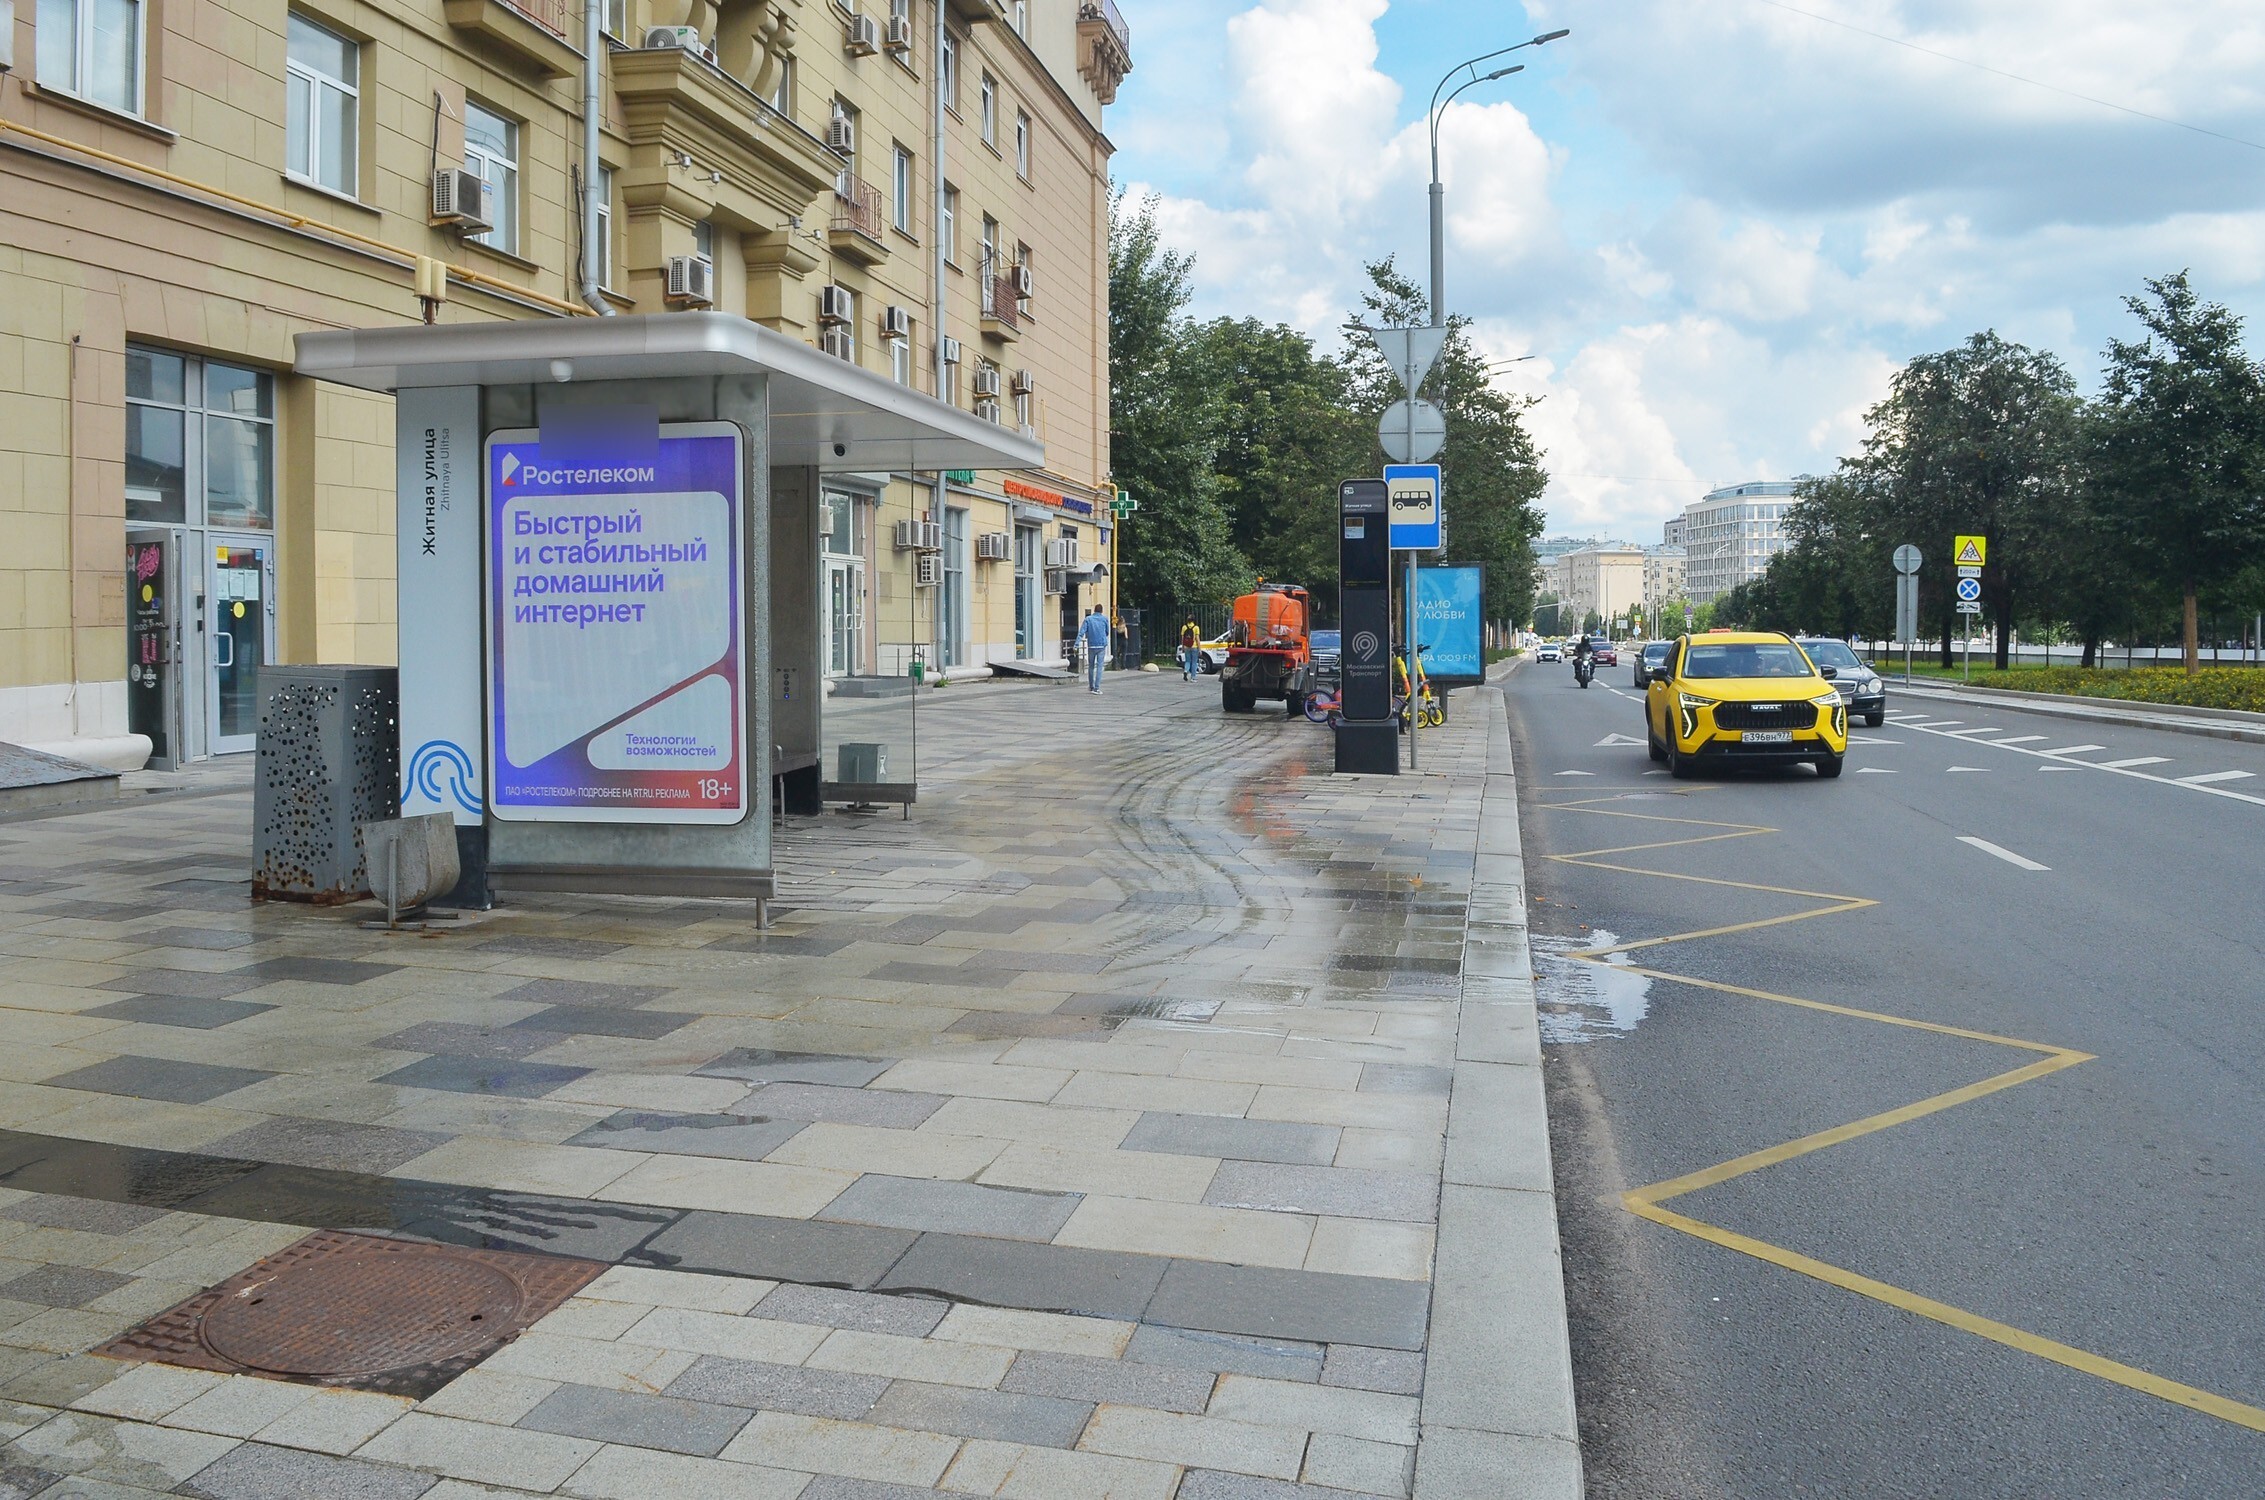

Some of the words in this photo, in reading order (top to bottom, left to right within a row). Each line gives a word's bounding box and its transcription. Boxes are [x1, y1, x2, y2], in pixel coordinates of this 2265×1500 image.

[424, 428, 438, 481] улица
[440, 428, 450, 460] Ulitsa
[440, 462, 452, 511] Zhitnaya
[522, 465, 655, 486] Ростелеком
[422, 486, 436, 556] Житная
[514, 508, 642, 541] Быстрый
[514, 546, 531, 565] и
[538, 537, 708, 565] стабильный
[513, 568, 665, 598] домашний
[514, 602, 646, 630] интернет
[1424, 610, 1466, 620] ЛЮБВИ
[1419, 654, 1435, 662] ЕРА
[1462, 653, 1477, 662] FM
[1349, 670, 1382, 678] Транспорт
[625, 733, 697, 746] Технологии
[625, 744, 717, 757] возможностей
[505, 786, 521, 796] ПАО
[521, 787, 578, 798] «РОСТЕЛЕКОМ».
[578, 788, 622, 799] ПОДРОБНЕЕ
[622, 788, 633, 798] НА
[633, 788, 655, 799] RT.RU.
[655, 788, 691, 799] РЕКЛАМА
[697, 778, 733, 800] 18+
